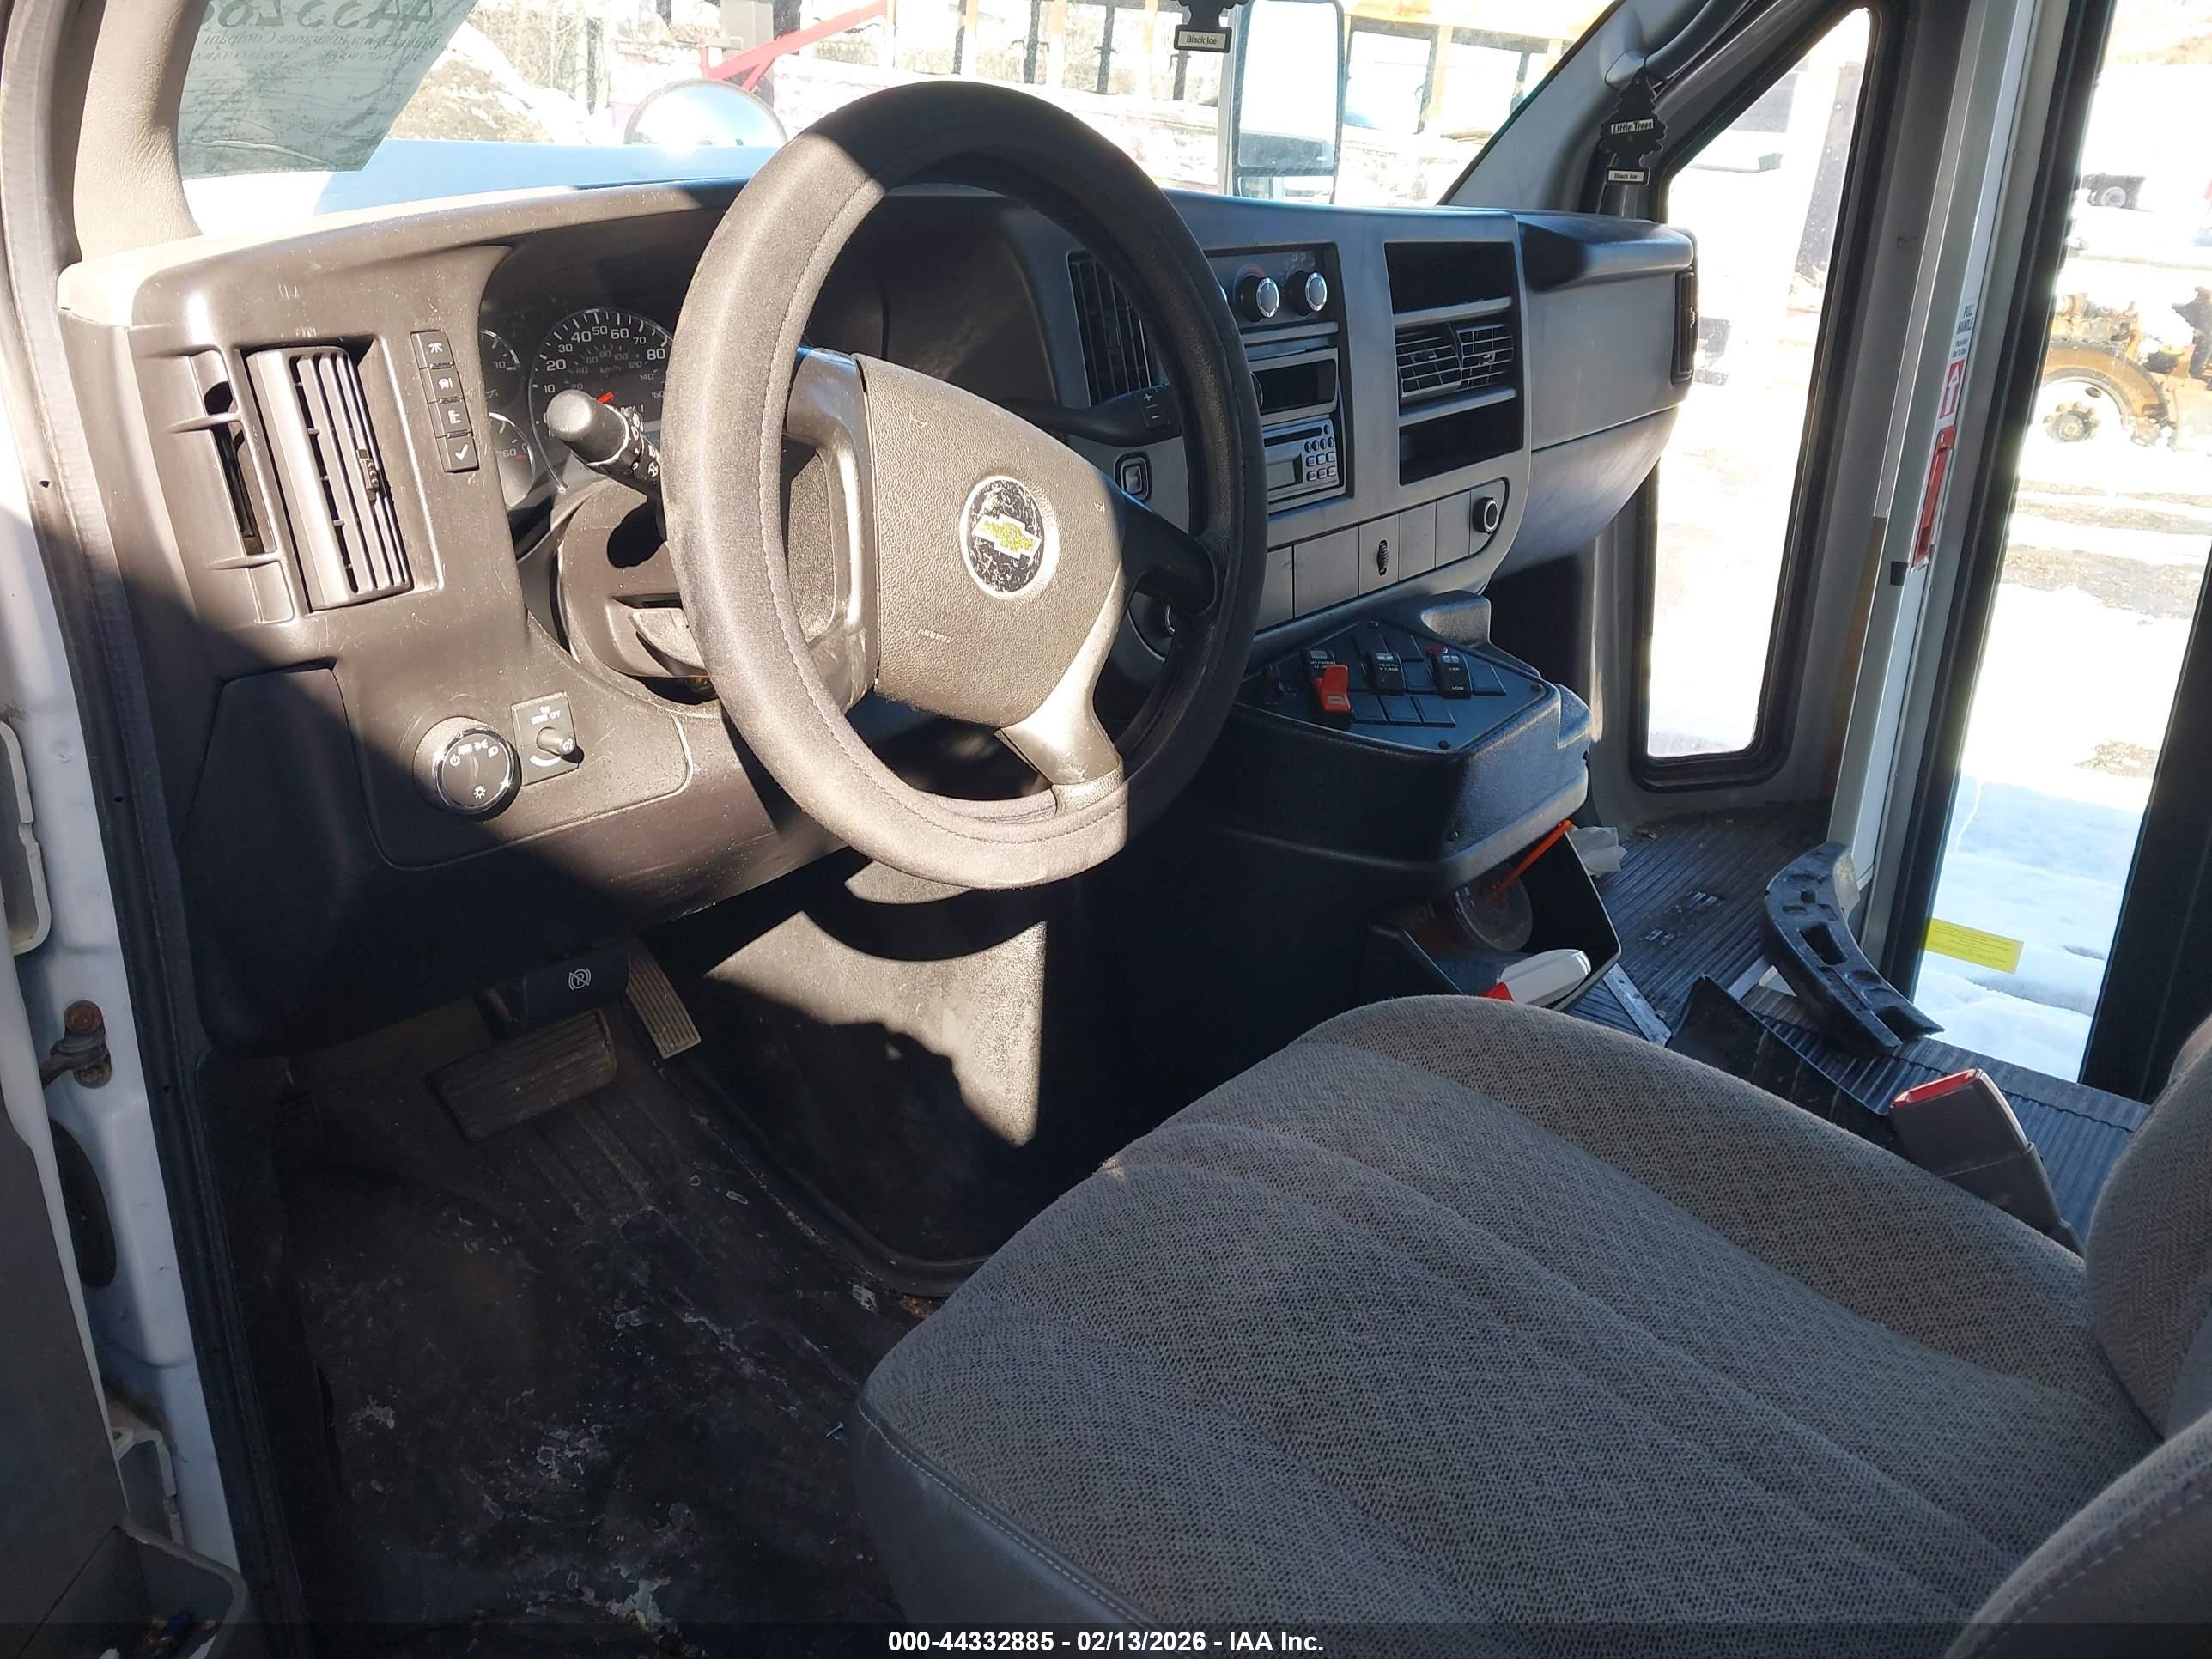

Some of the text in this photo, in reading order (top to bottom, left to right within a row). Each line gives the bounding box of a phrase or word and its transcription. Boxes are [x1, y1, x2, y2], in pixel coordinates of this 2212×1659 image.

[1186, 35, 1218, 45] Black Ice
[1613, 120, 1653, 133] Little Trees
[592, 325, 608, 336] 50
[611, 328, 629, 339] 60
[571, 331, 592, 343] 40
[633, 337, 646, 345] 70
[558, 343, 573, 353] 30
[647, 349, 665, 360] 80
[546, 359, 567, 372] 20
[543, 385, 556, 393] 10
